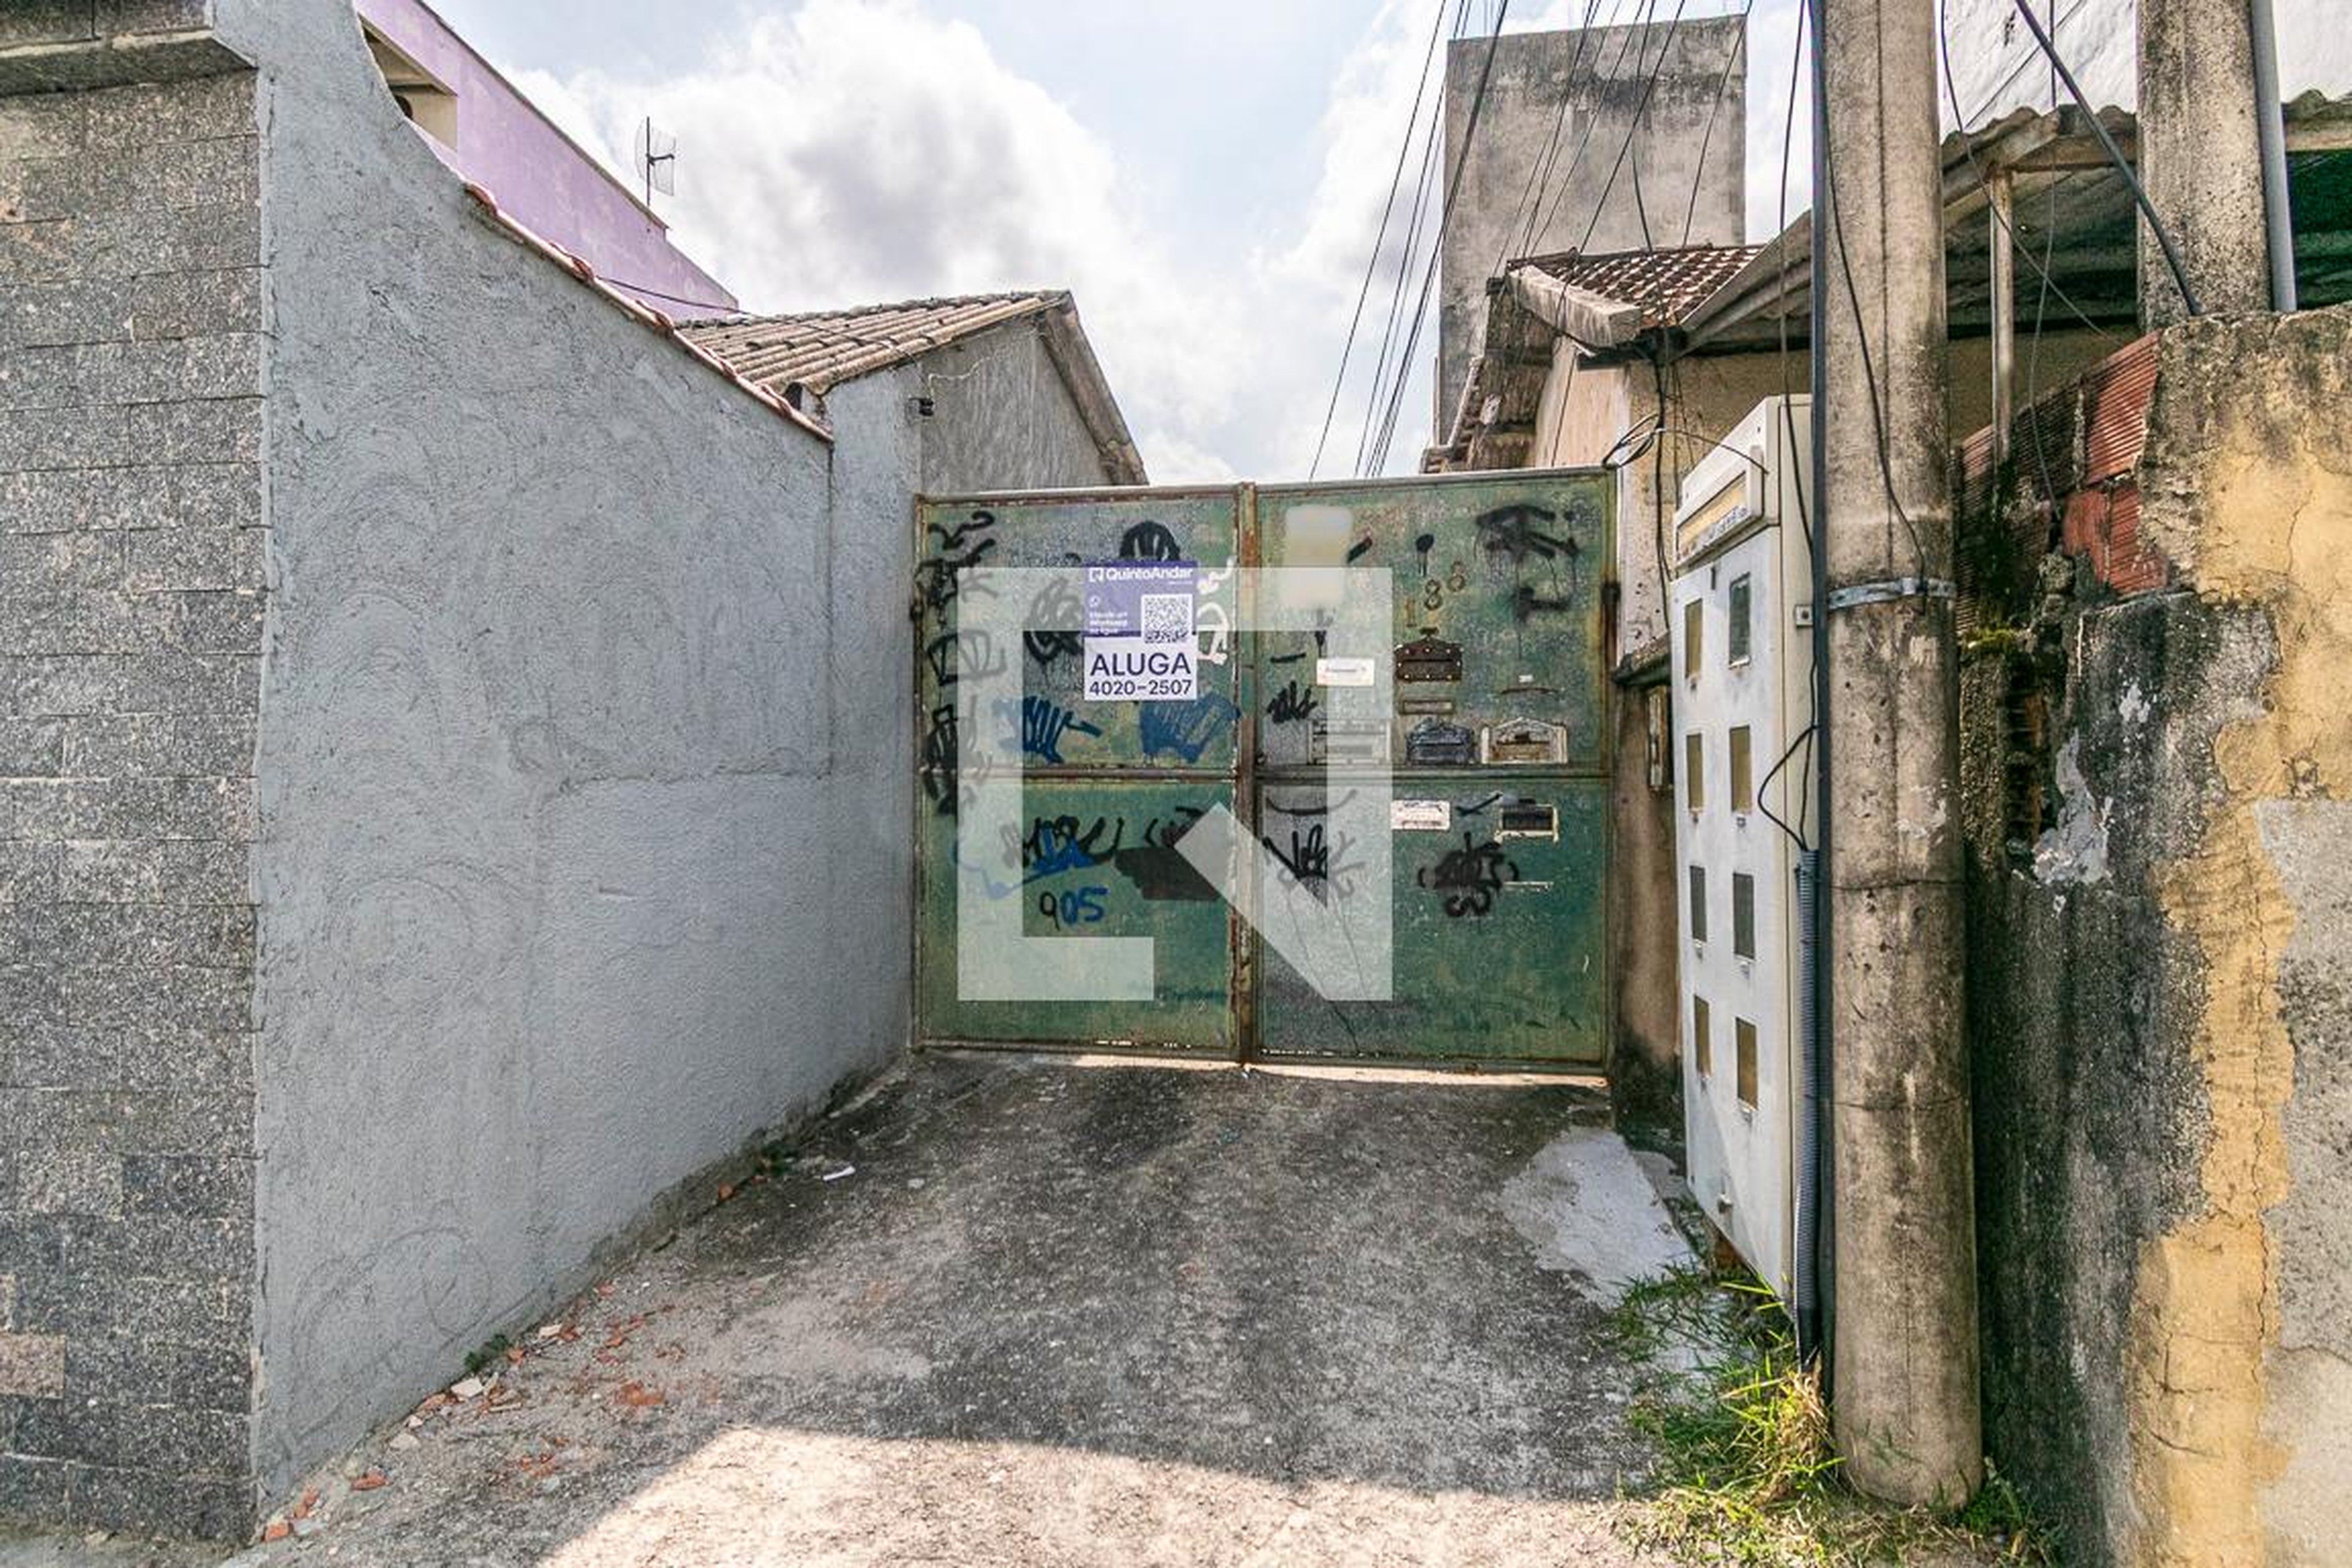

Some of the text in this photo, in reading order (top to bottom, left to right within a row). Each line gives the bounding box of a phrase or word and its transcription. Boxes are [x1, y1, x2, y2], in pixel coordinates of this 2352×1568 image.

[1106, 566, 1193, 581] QuintoAndar
[1090, 652, 1191, 676] ALUGA
[1090, 680, 1192, 696] 4020-2507
